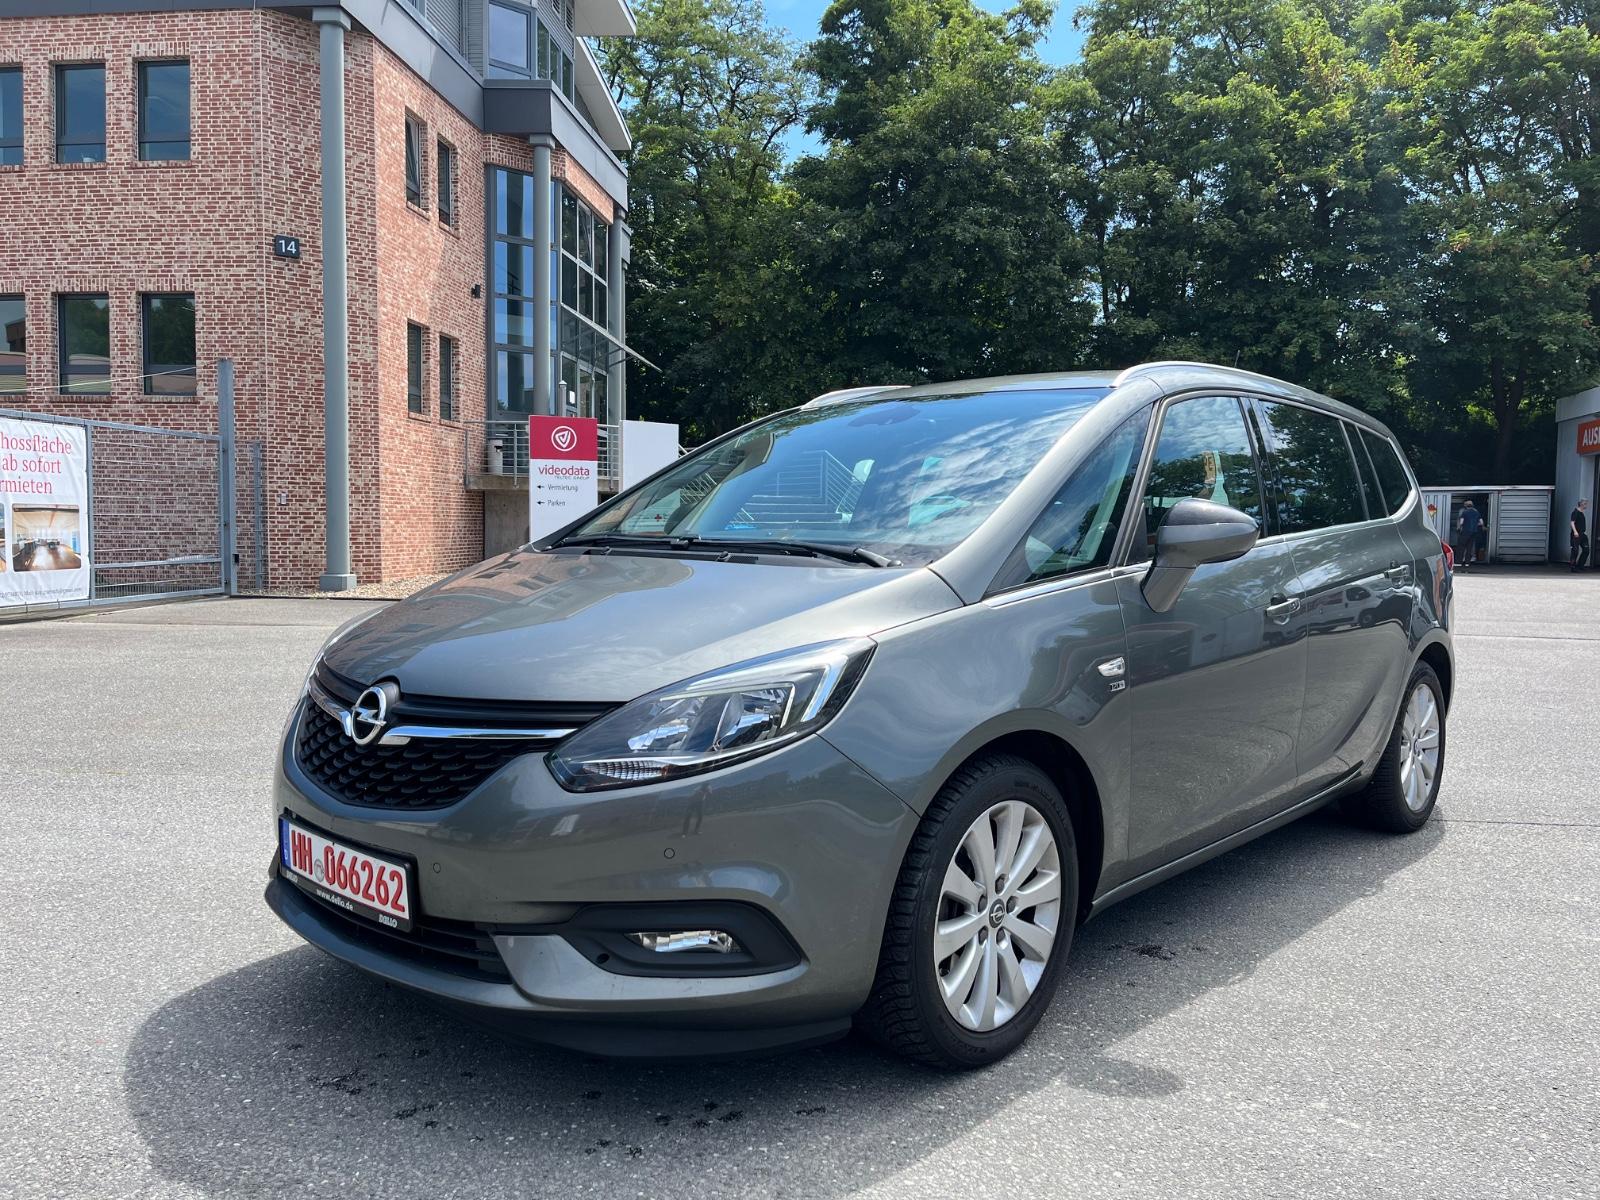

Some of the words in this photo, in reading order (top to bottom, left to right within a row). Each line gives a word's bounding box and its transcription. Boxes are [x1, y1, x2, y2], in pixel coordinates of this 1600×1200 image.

[279, 239, 297, 254] 14
[1582, 425, 1600, 447] AUS
[2, 453, 18, 471] ab
[22, 456, 62, 474] sofort
[537, 464, 590, 476] videodata
[547, 483, 579, 492] Vermietung
[547, 499, 566, 507] Parken
[291, 829, 313, 875] HH
[323, 845, 406, 913] 066262
